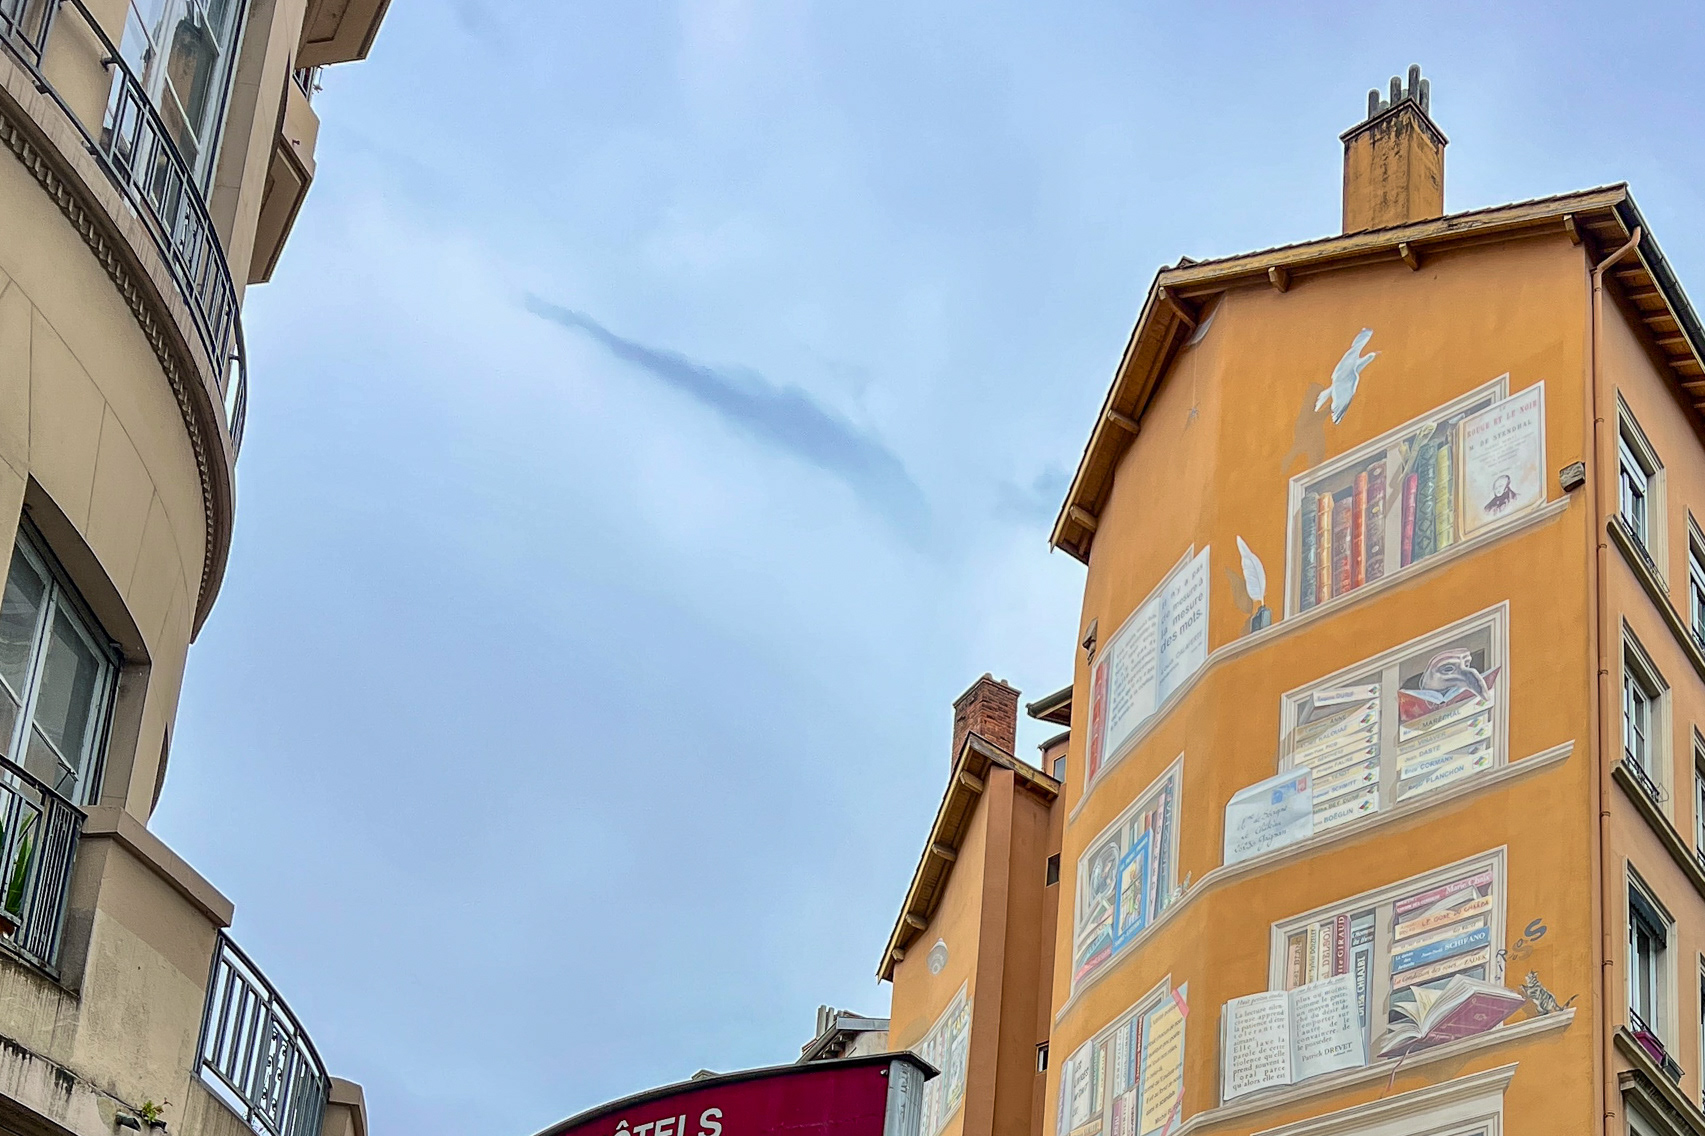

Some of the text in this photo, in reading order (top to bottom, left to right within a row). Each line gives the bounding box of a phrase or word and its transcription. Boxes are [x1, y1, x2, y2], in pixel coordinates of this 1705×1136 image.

[1172, 593, 1204, 626] mesure
[1160, 633, 1177, 654] des
[1425, 765, 1464, 784] PLANCHON
[1444, 932, 1486, 951] SCHIFANO
[1258, 1009, 1284, 1020] apprend
[1324, 1041, 1353, 1055] DREVET
[1233, 1050, 1256, 1062] parole
[1233, 1064, 1252, 1074] prend
[1264, 1066, 1285, 1076] parce
